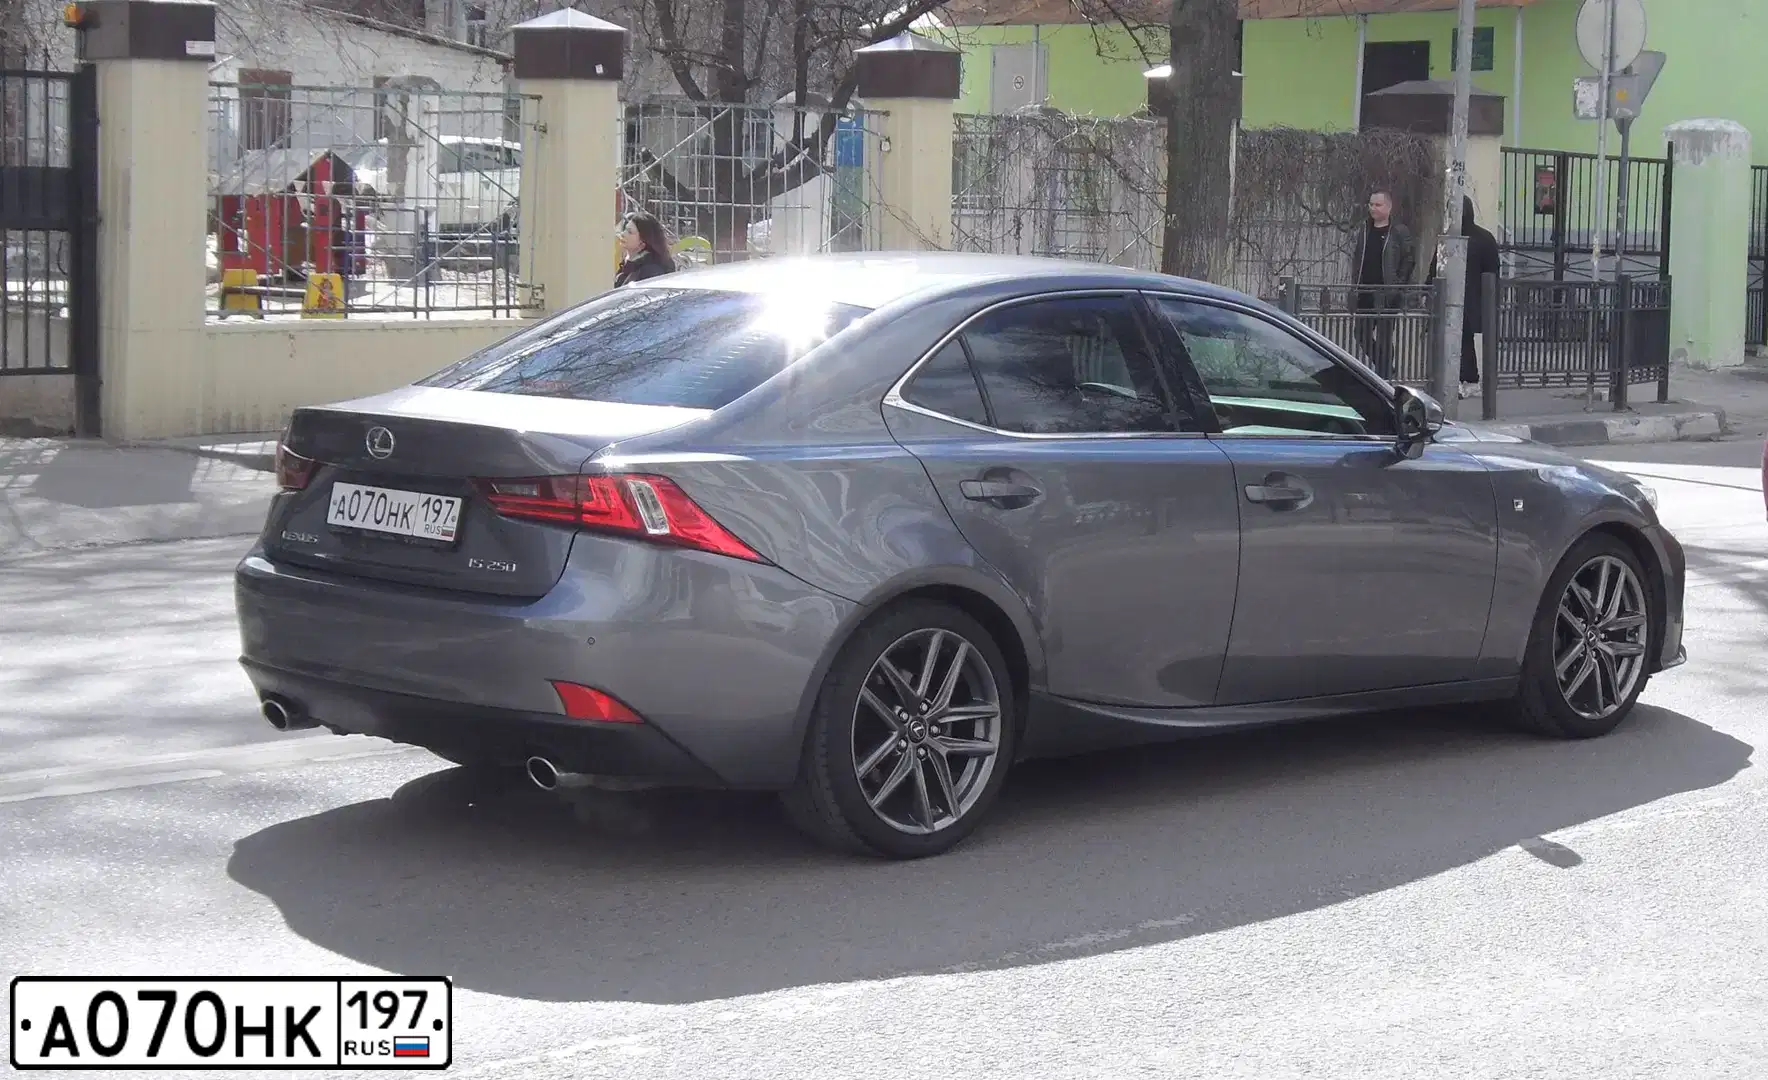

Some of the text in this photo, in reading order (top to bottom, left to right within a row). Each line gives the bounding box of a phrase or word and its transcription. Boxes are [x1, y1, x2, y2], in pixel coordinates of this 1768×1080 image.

[1452, 160, 1465, 171] 29
[334, 489, 455, 530] А070НК 197
[423, 523, 441, 535] RUS
[469, 558, 517, 572] IS 250
